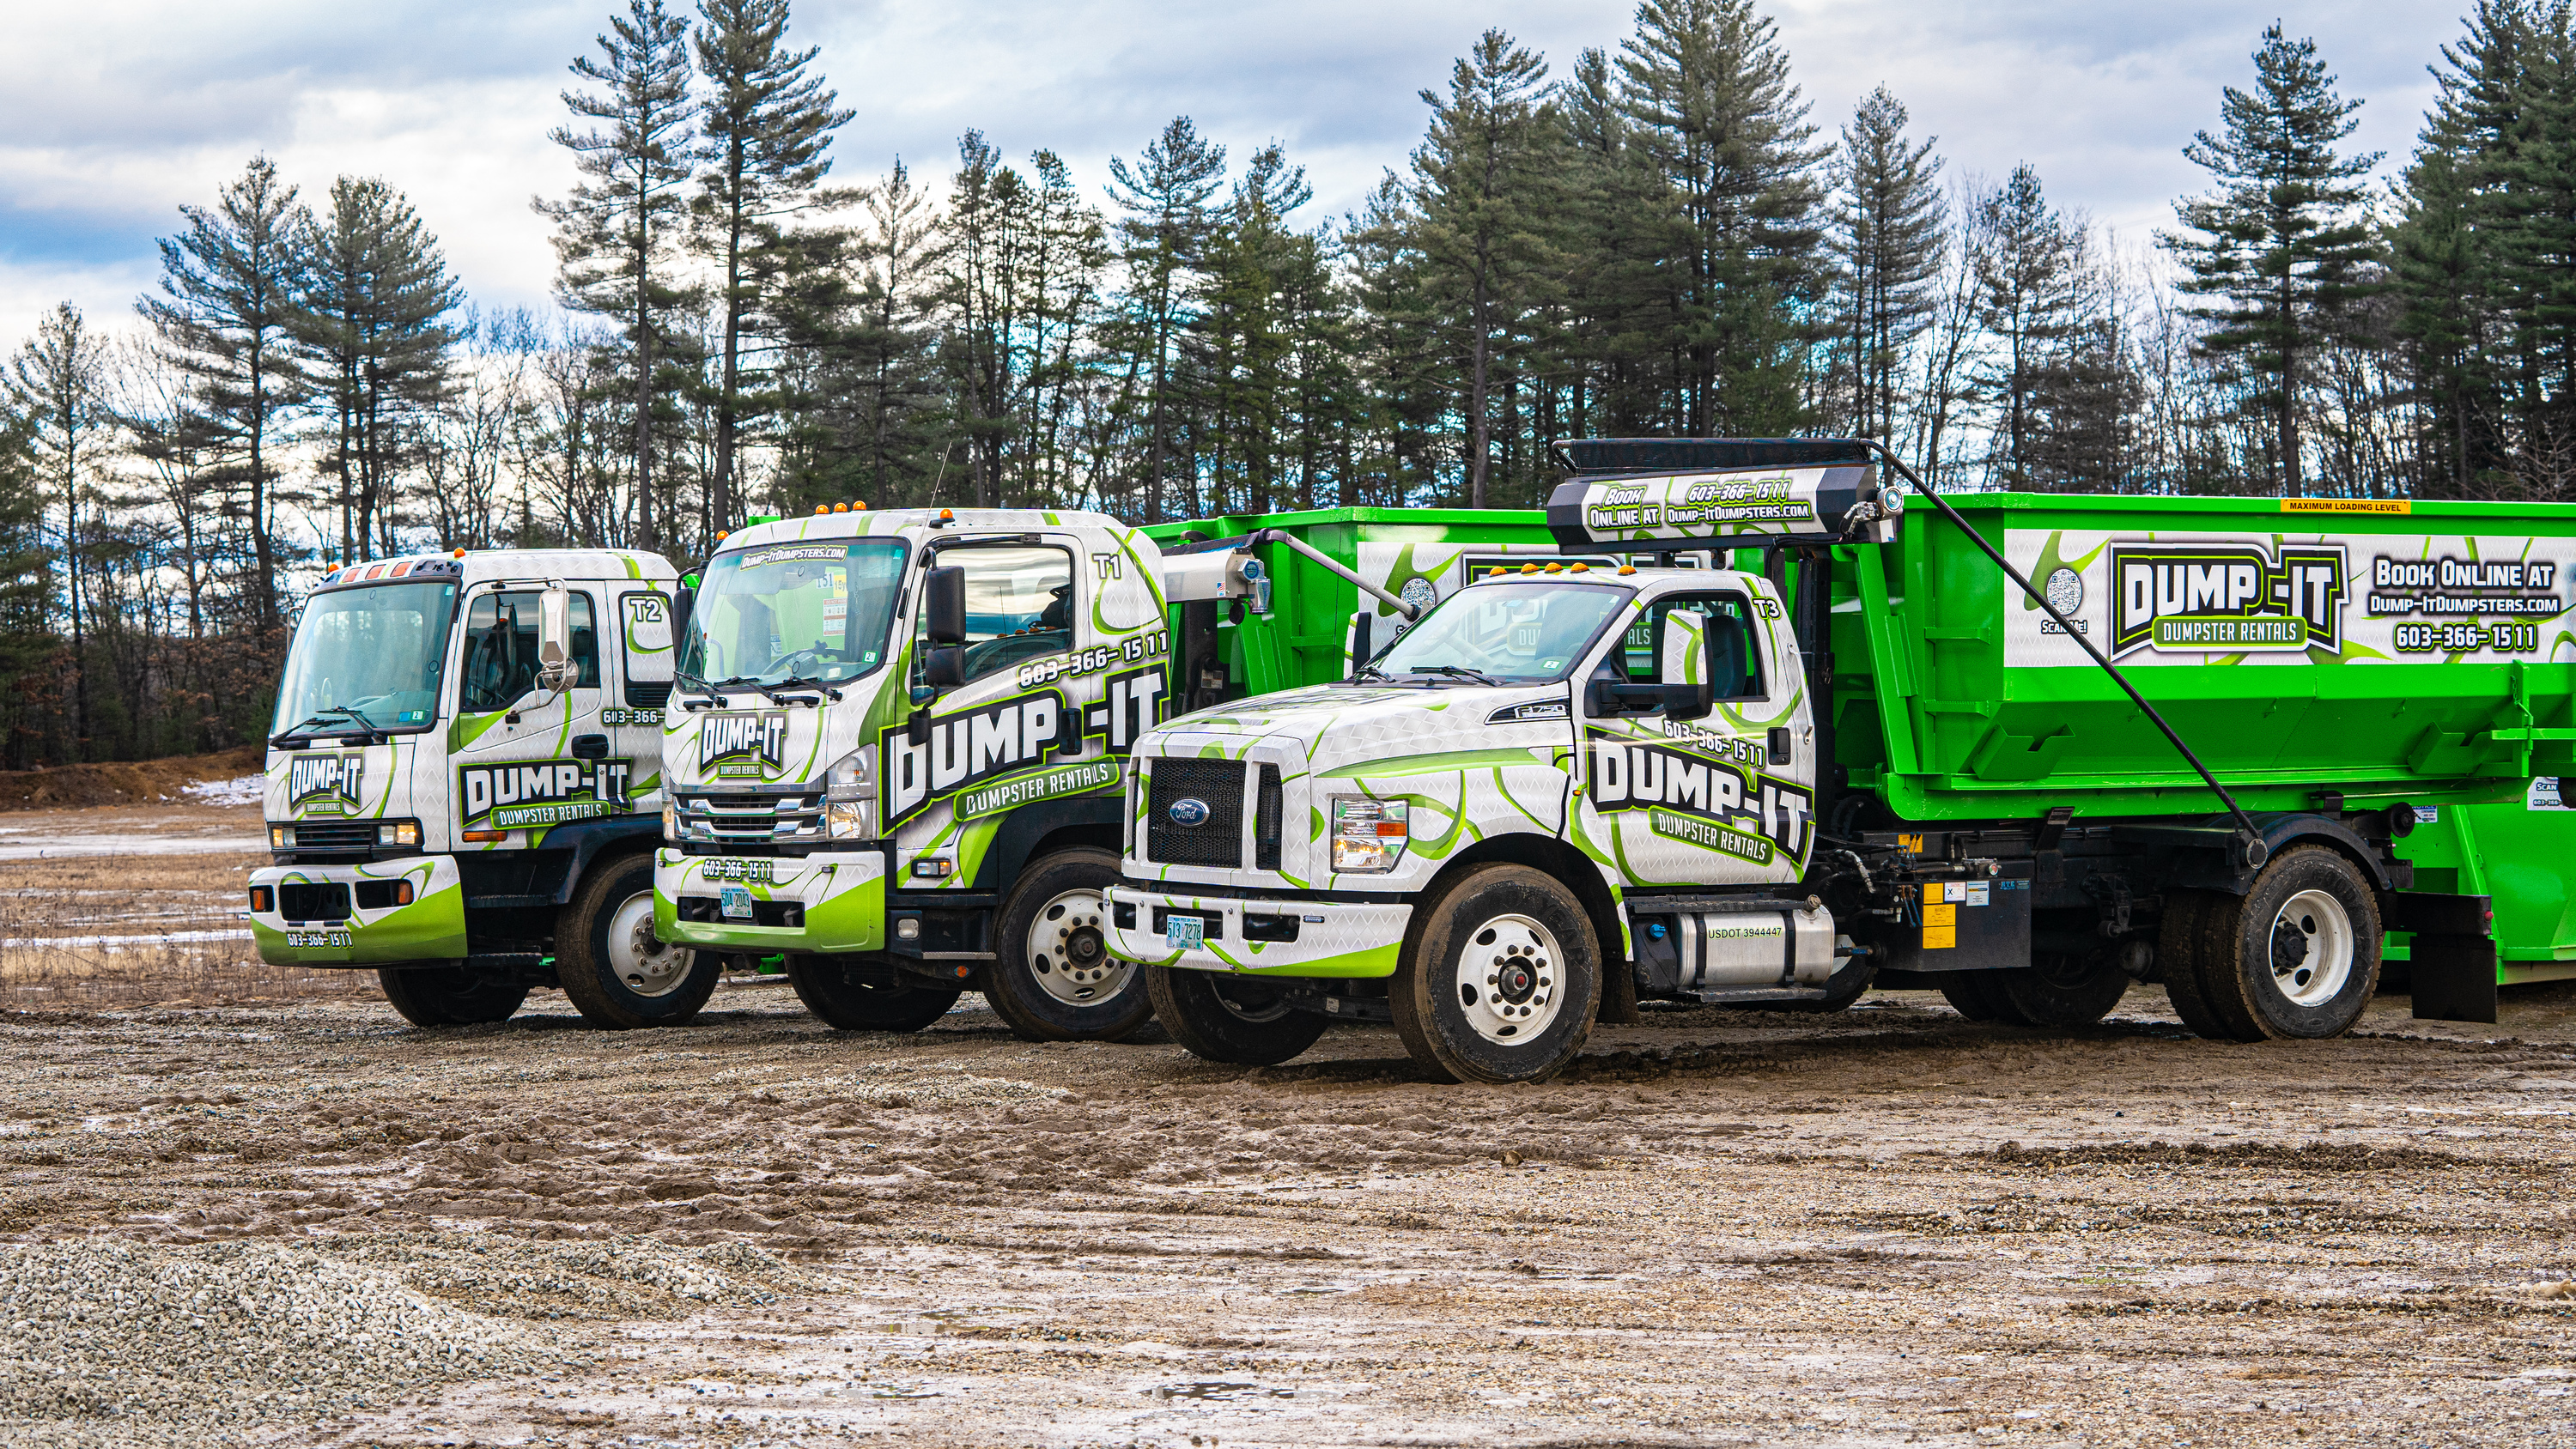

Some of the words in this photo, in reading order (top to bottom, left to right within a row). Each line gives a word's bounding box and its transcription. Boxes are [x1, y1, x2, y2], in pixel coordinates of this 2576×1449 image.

[1688, 482, 1791, 501] 603-366-1511
[1093, 554, 1121, 579] T1
[2125, 564, 2332, 631] DUMP-IT
[630, 599, 661, 621] T2
[1753, 599, 1779, 618] T3
[2163, 622, 2235, 641] DUMPSTER
[2240, 622, 2297, 641] RENTALS
[2397, 626, 2534, 646] 603-366-1511
[1020, 633, 1169, 688] 603-366-1511
[702, 717, 784, 765] DUMP-IT
[890, 672, 1163, 820] DUMP-IT
[1663, 719, 1764, 768] 603-366-1511
[720, 765, 741, 775] DUMPSTER
[742, 765, 759, 774] RENTALS
[291, 758, 361, 803] DUMP-IT
[466, 764, 628, 816] DUMP-IT
[965, 779, 1045, 815] DUMPSTER
[1050, 763, 1109, 797] RENTALS
[1595, 737, 1807, 853] DUMP-IT
[307, 803, 325, 812] DUMPSTER
[325, 803, 340, 811] RENTALS
[499, 807, 556, 826] DUMPSTER
[1176, 803, 1197, 820] Ford
[1657, 812, 1717, 847] DUMPSTER
[1720, 829, 1766, 861] RENTALS
[703, 859, 771, 879] 603-366-1511
[722, 892, 733, 906] 504
[735, 893, 750, 907] 2043
[287, 932, 353, 947] 603-366-1511
[1168, 921, 1181, 938] 513
[1185, 923, 1201, 940] 7278
[1708, 928, 1741, 939] USDOT
[1743, 927, 1782, 937] 3944447
